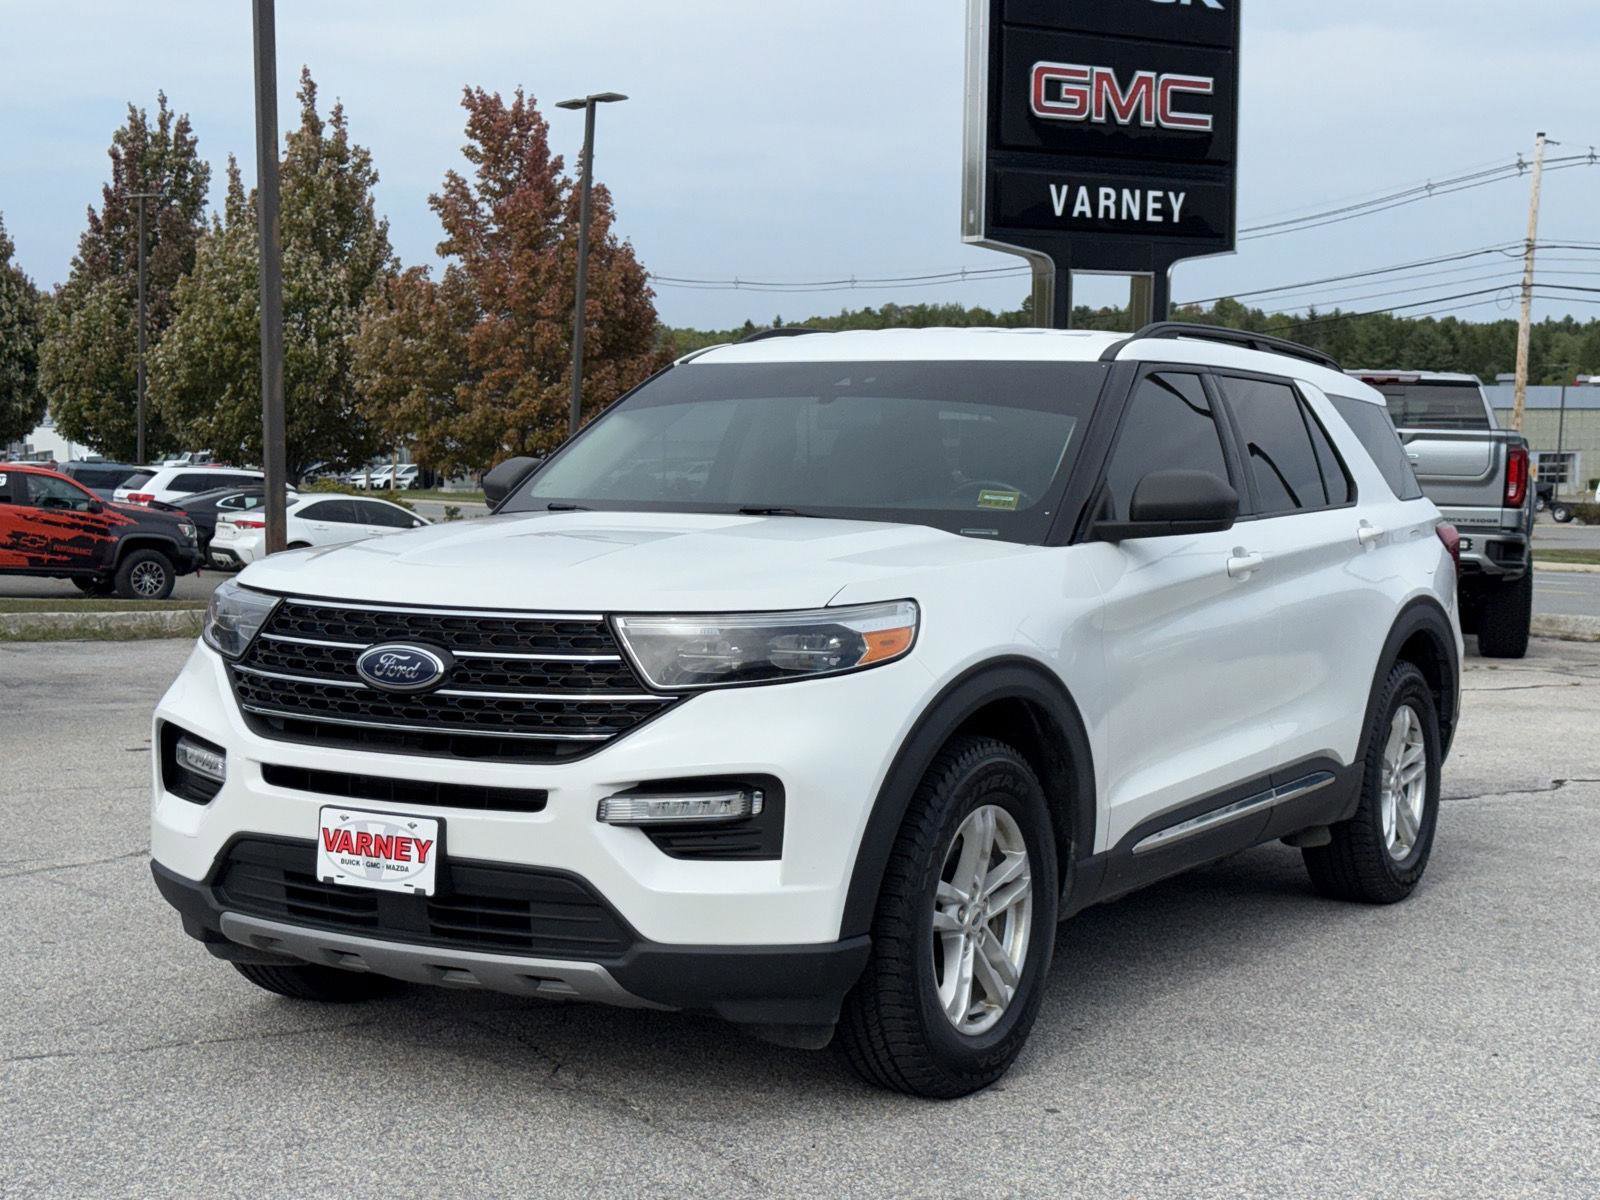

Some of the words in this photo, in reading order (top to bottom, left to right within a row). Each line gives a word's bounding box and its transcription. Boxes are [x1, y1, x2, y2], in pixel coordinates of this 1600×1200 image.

[1031, 61, 1213, 132] GMC
[1050, 184, 1186, 223] VARNEY
[374, 653, 421, 679] Ford
[322, 827, 433, 863] VARNEY
[340, 858, 361, 866] BUICK
[365, 861, 381, 869] GMC
[385, 864, 409, 872] MAZDA
